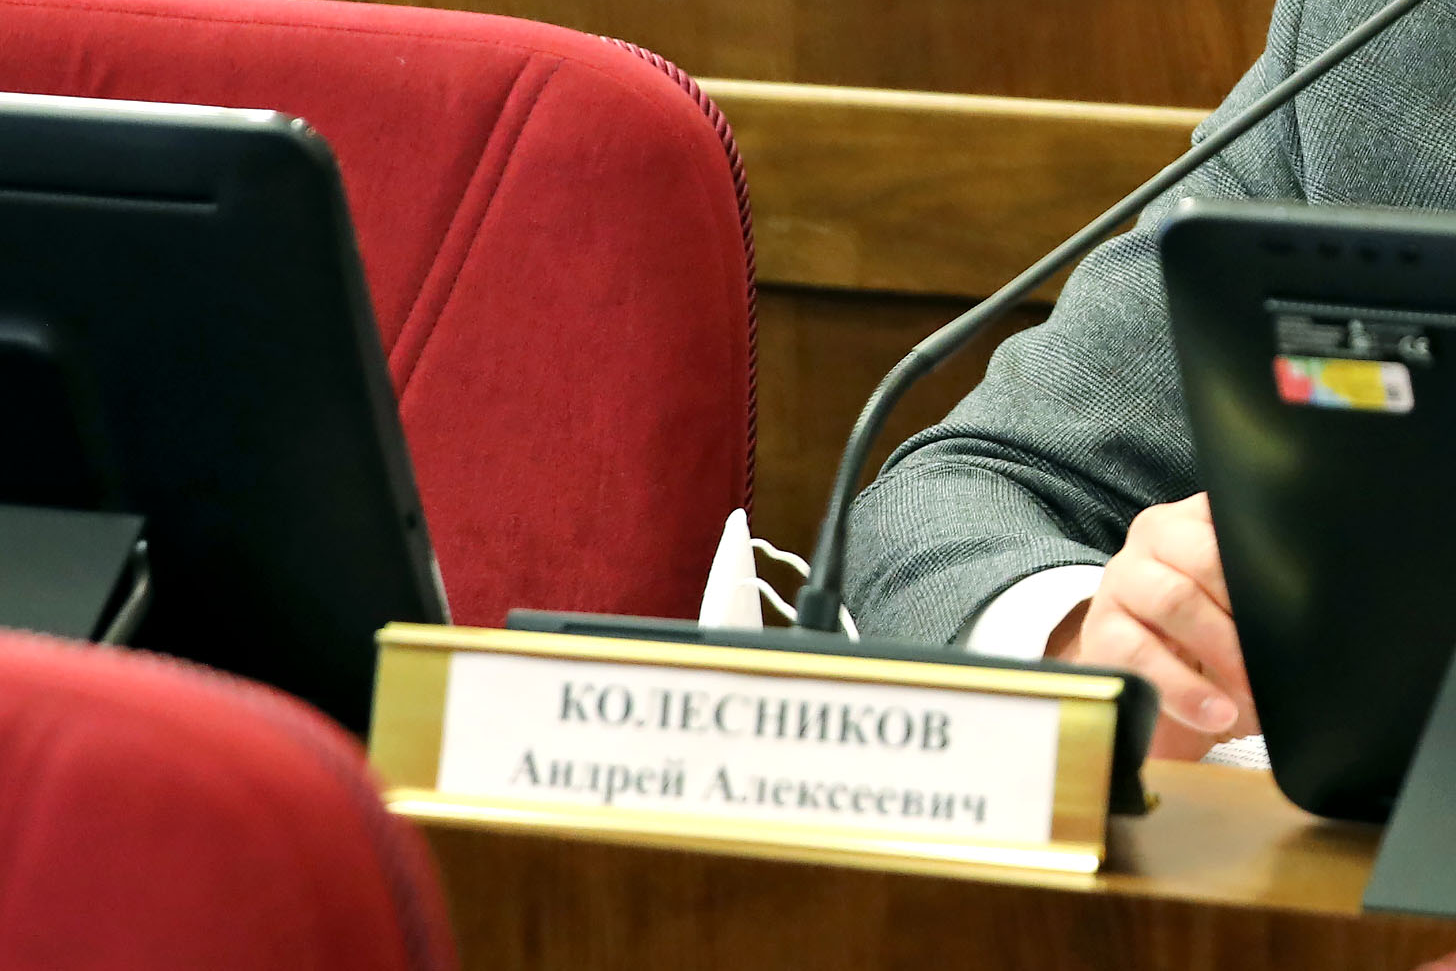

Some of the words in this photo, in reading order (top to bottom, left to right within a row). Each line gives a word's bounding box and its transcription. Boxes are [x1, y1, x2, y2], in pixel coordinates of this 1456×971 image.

[558, 681, 951, 751] КОЛЕСНИКОВ
[511, 748, 685, 804] Андрей
[709, 766, 987, 825] Алексеевич
